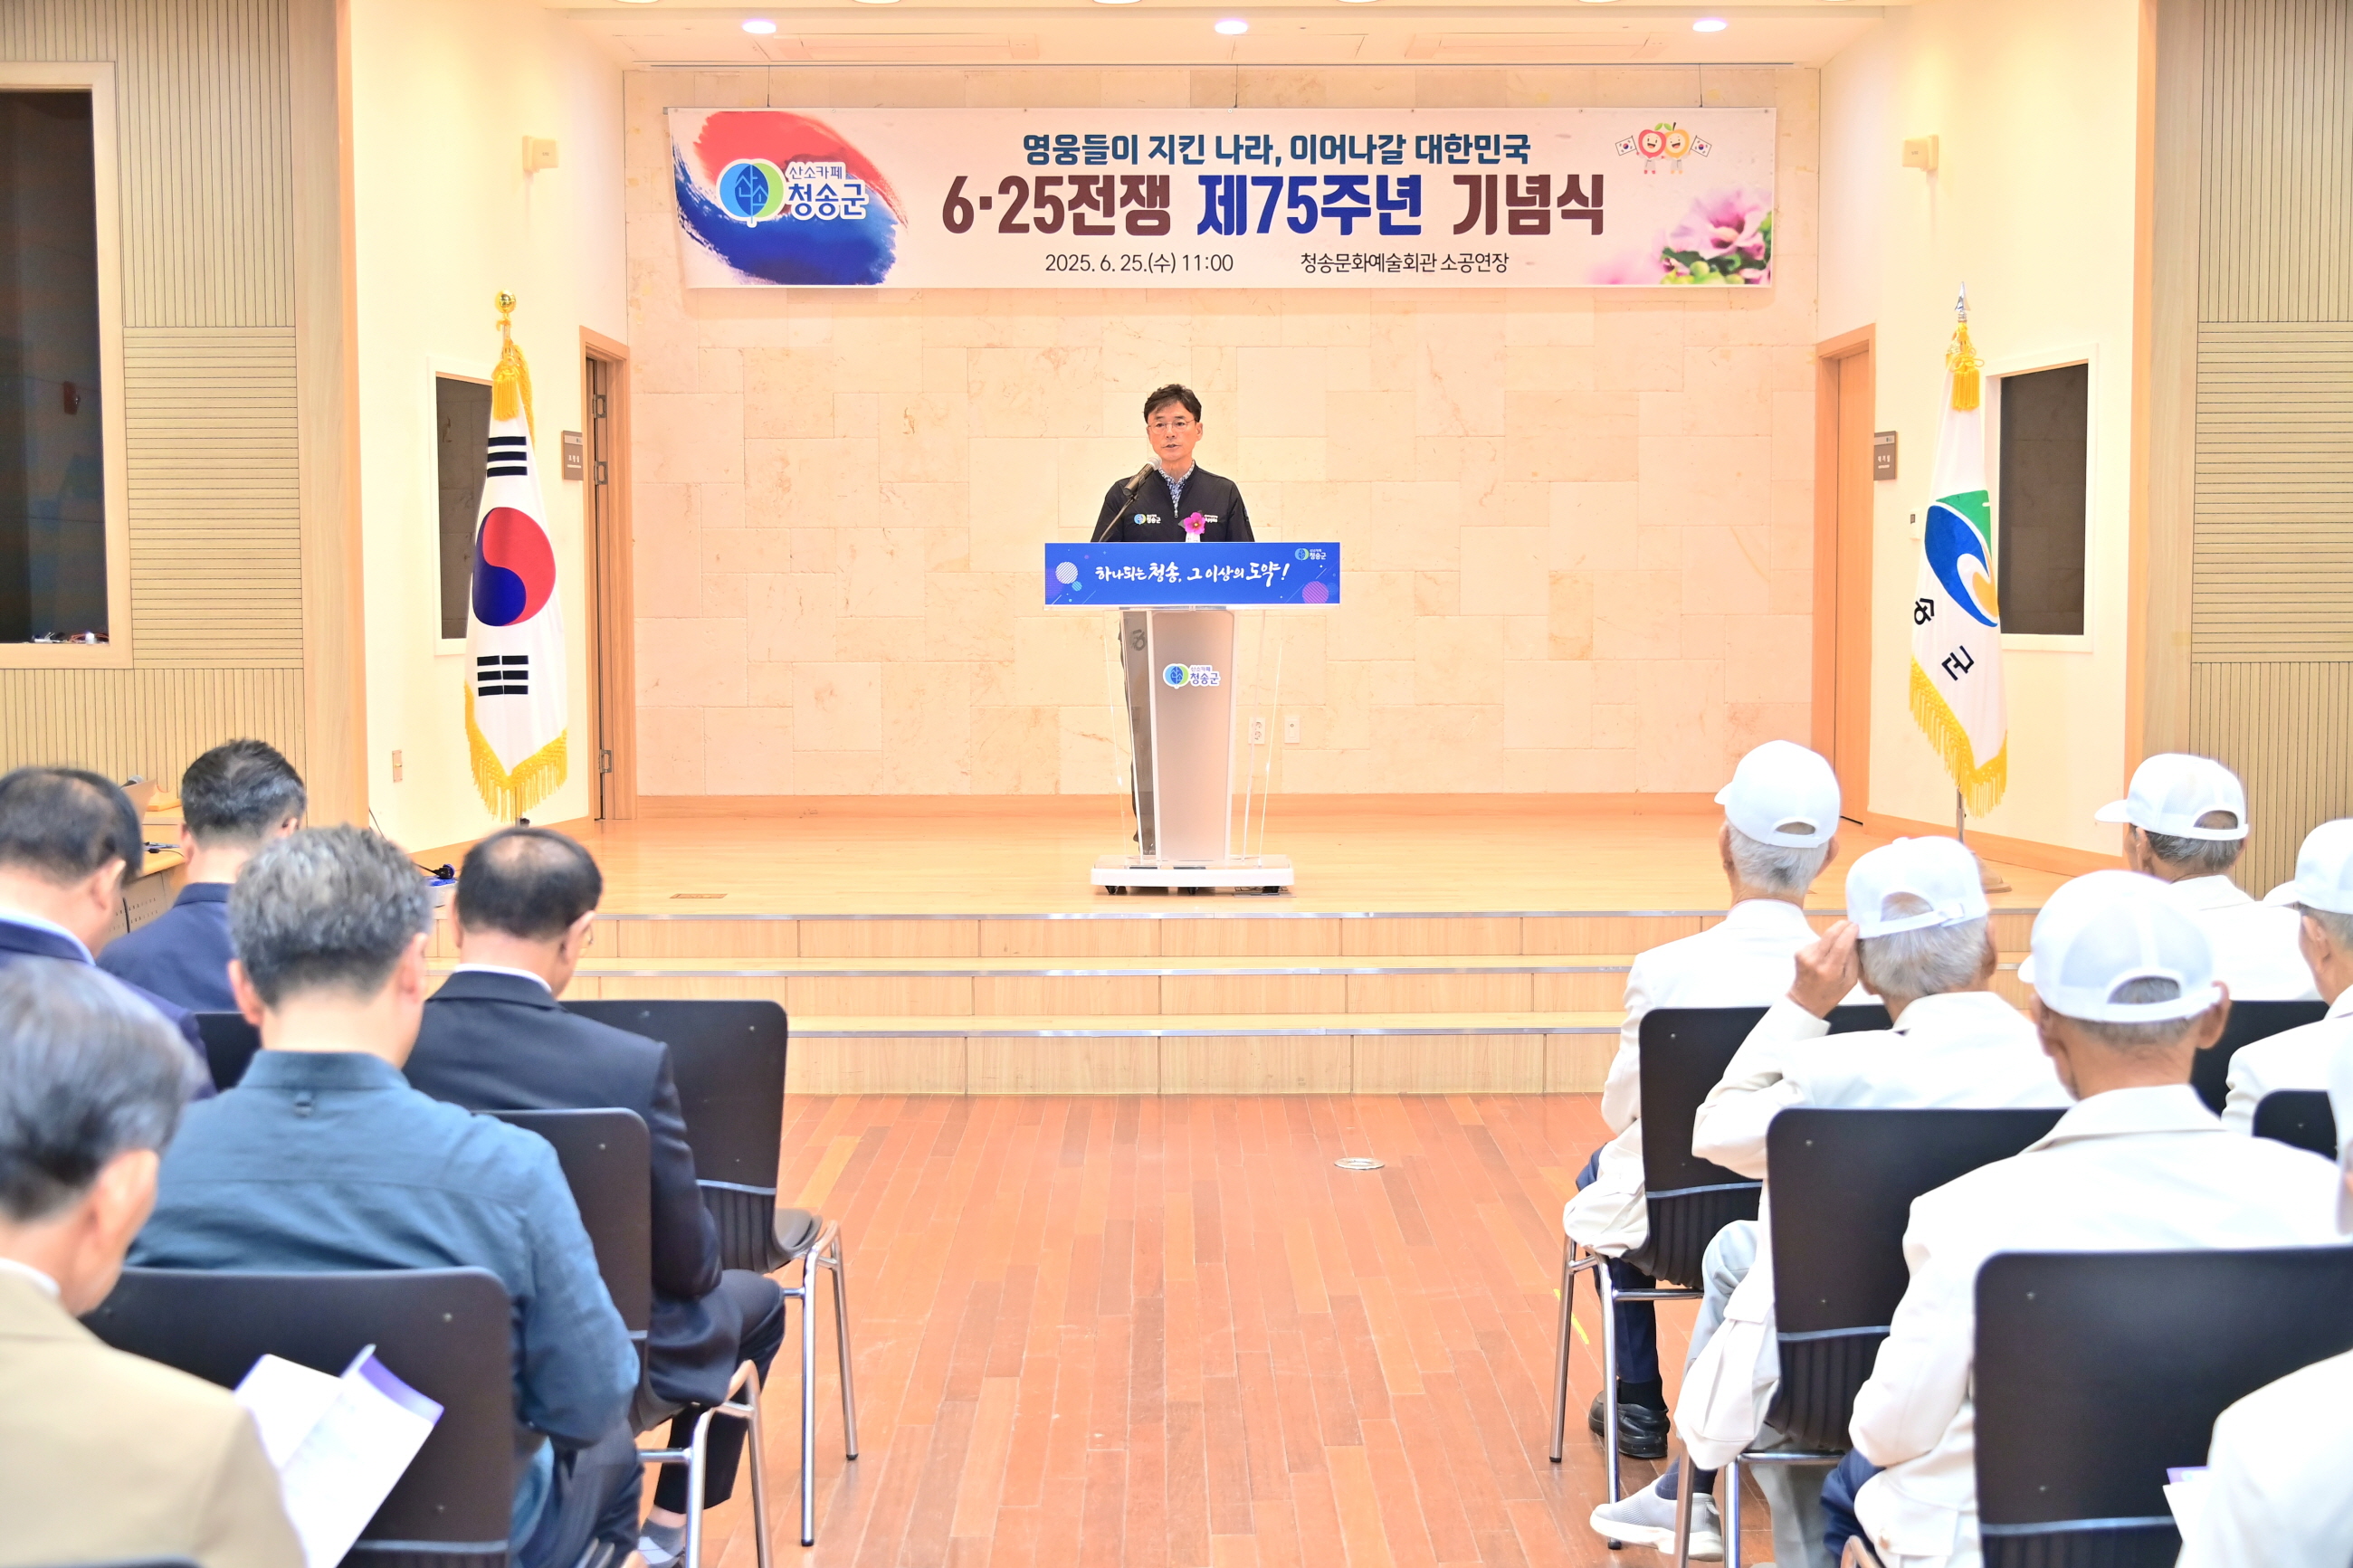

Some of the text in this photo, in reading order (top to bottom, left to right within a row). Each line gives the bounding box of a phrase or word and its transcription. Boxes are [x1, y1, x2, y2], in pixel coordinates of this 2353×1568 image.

[1024, 134, 1530, 167] 영웅들이 지킨 나라, 이어나갈 대한민국
[789, 166, 843, 180] 산소카페
[788, 183, 865, 216] 청송군
[1197, 175, 1422, 236] 제75주년
[1453, 174, 1604, 236] 기념식
[1046, 252, 1234, 273] 2025. 6. 25.(수) 11:00
[1300, 252, 1510, 273] 청송문화예술회관 소공연장
[1310, 552, 1327, 560] 청송군
[1095, 561, 1291, 588] 하나되는 청송, 그 이상의 도약!
[1190, 672, 1219, 685] 청송군
